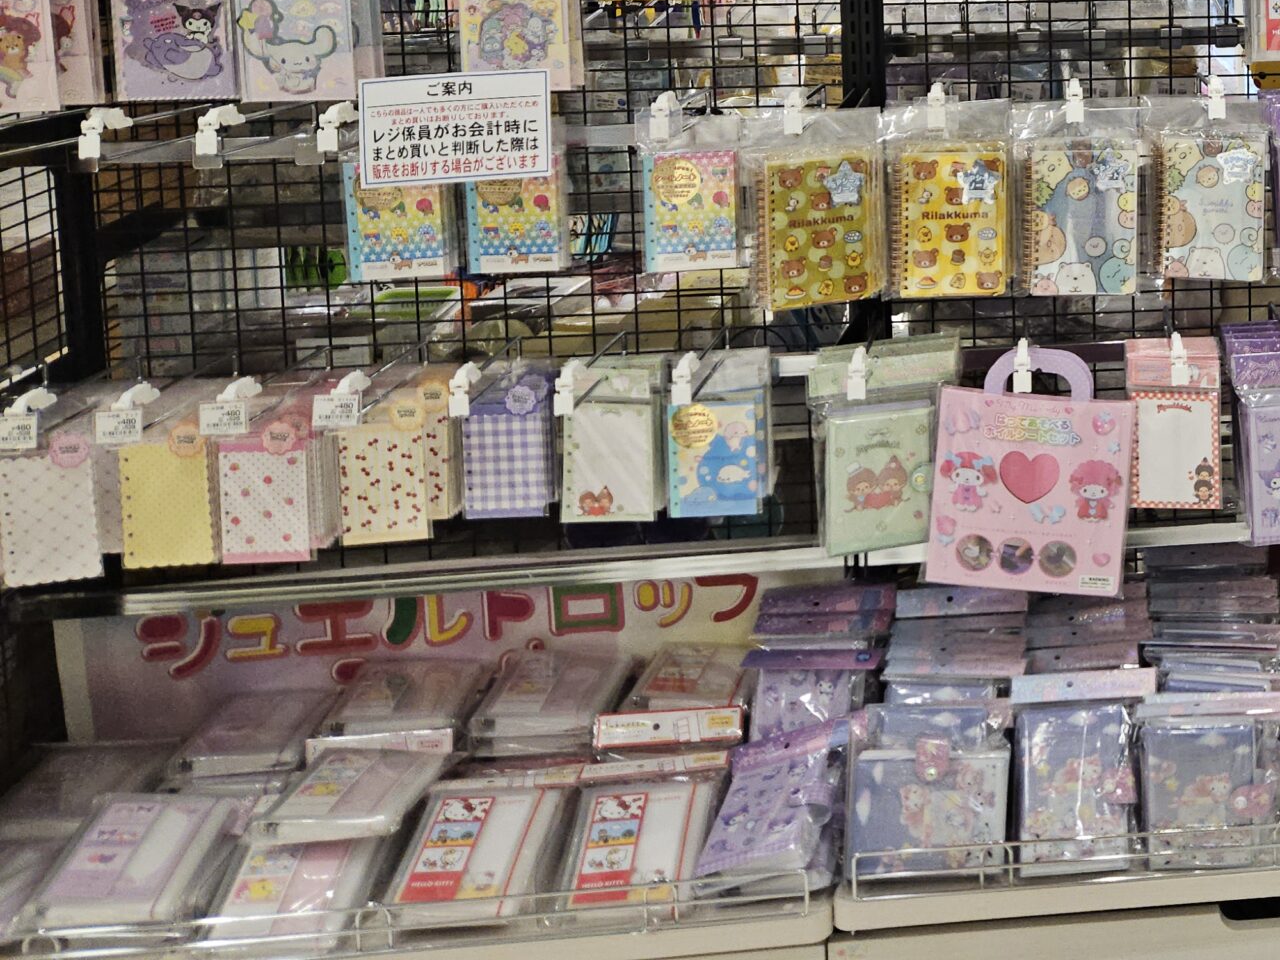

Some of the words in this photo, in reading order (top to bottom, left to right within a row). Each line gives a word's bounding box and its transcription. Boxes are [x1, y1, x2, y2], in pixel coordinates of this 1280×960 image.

[426, 81, 473, 97] ご案内
[373, 119, 538, 143] レジ係員がお会計時に
[372, 137, 539, 161] まとめ買いと判断した際は
[372, 153, 540, 180] 販売をお断りする場合がございます
[788, 213, 855, 229] Rilakkuma
[921, 209, 989, 222] Rilakkuma
[996, 414, 1072, 432] はってあそべる
